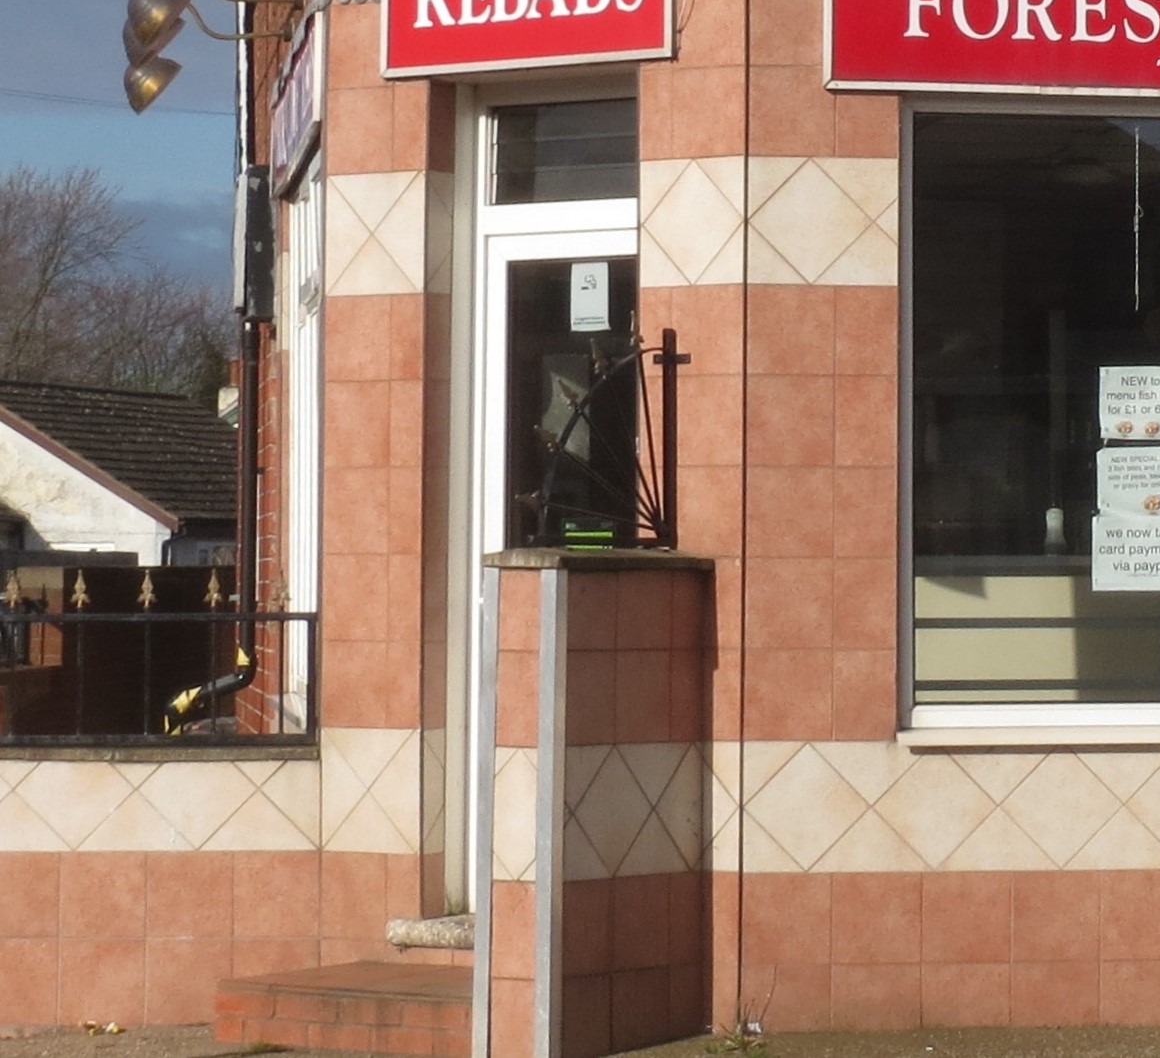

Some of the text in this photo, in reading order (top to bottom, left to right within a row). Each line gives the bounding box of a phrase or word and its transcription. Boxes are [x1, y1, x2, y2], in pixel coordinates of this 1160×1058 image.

[1121, 376, 1148, 386] NEW
[1151, 377, 1160, 386] to
[1106, 392, 1136, 400] menu
[1139, 390, 1157, 400] fish
[1107, 404, 1121, 415] for
[1125, 405, 1136, 414] £1
[1140, 406, 1151, 414] or
[1111, 455, 1128, 463] NEW
[1130, 454, 1159, 462] SPECIAL
[1106, 529, 1123, 538] we
[1126, 529, 1151, 538] now
[1099, 544, 1125, 555] card
[1113, 560, 1130, 571] via
